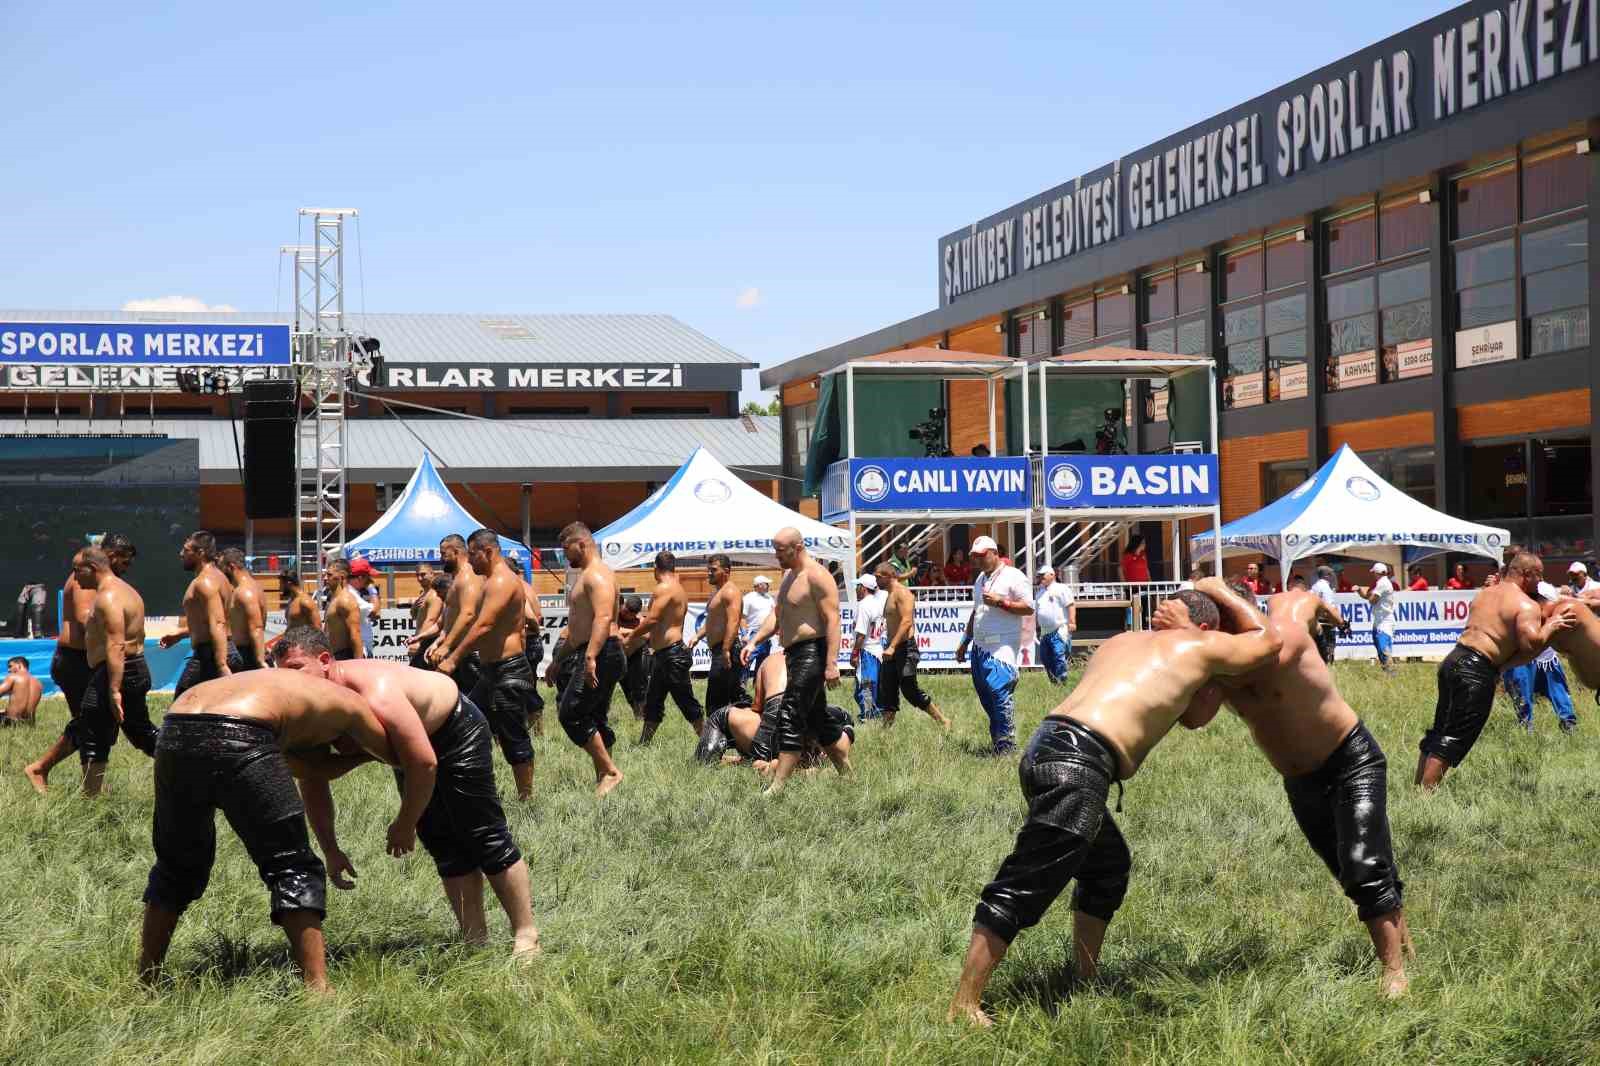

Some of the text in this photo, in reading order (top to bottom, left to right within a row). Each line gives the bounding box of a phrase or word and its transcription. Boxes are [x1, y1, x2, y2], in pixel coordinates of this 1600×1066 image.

[1022, 159, 1121, 270] BELEDİYESİ
[1129, 116, 1264, 230] GELENEKSEL
[1277, 50, 1412, 178] SPORLAR
[1, 331, 264, 356] SPORLAR MERKEZİ
[508, 364, 683, 388] MERKEZİ
[893, 468, 1025, 493] CANLI YAYIN
[1091, 464, 1209, 496] BASIN
